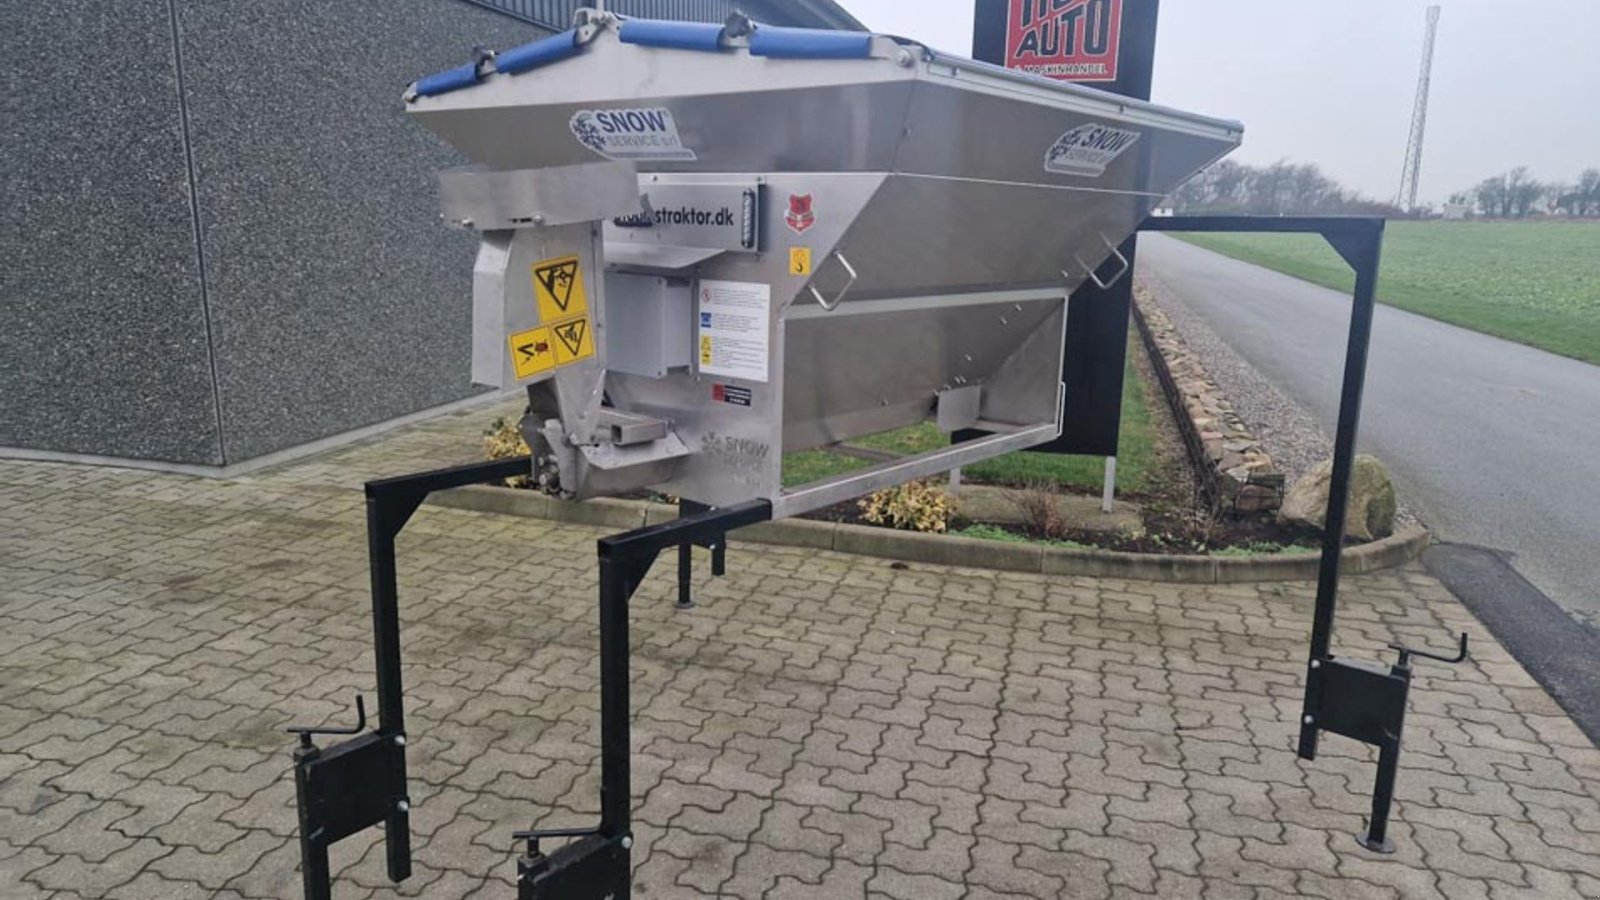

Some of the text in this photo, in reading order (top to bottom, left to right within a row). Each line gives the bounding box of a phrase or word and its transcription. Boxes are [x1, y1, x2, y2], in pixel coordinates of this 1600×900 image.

[1015, 1, 1110, 58] AUTO
[596, 109, 666, 133] SNOW
[606, 134, 661, 147] SERVICE
[1081, 128, 1136, 152] SNOW
[654, 206, 735, 227] straktor.dk
[725, 435, 769, 459] SNOW
